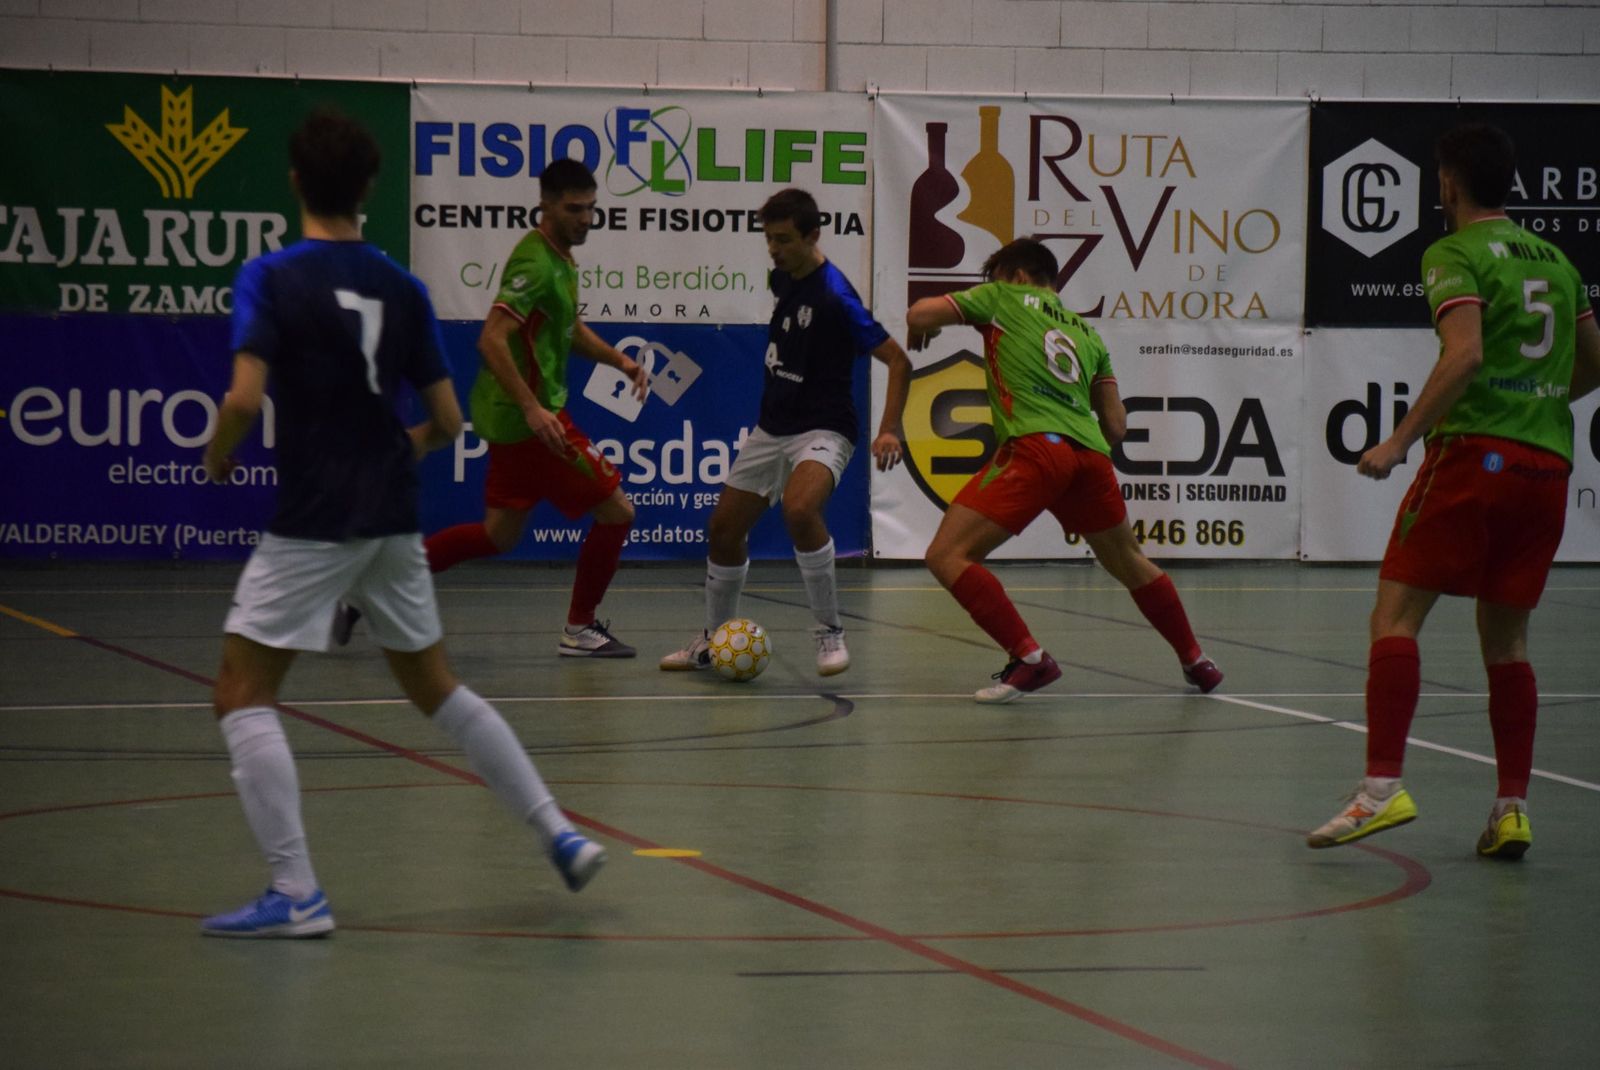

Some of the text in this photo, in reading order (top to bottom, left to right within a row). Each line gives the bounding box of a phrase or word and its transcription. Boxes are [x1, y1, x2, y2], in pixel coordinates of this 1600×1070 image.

[414, 121, 601, 177] FISIO
[696, 127, 867, 185] LIFE
[1028, 115, 1198, 202] RUTA
[1510, 167, 1600, 200] ARB
[639, 207, 865, 236] FISIOTEPIA
[1034, 208, 1102, 227] DEL
[1099, 185, 1281, 272] VINO
[0, 205, 137, 268] AJA
[1188, 264, 1228, 282] DE
[59, 282, 234, 315] DE ZAMO
[1351, 280, 1425, 298] www.es
[576, 302, 711, 318] ZAMORA
[1520, 278, 1556, 359] 5
[334, 289, 384, 396] 7
[1043, 328, 1081, 384] 6
[1138, 343, 1294, 359] serafin@sedaseguridad.es
[108, 457, 278, 486] electroom
[680, 493, 689, 510] y
[1186, 484, 1287, 502] SEGURIDAD
[1132, 519, 1245, 546] 446 866
